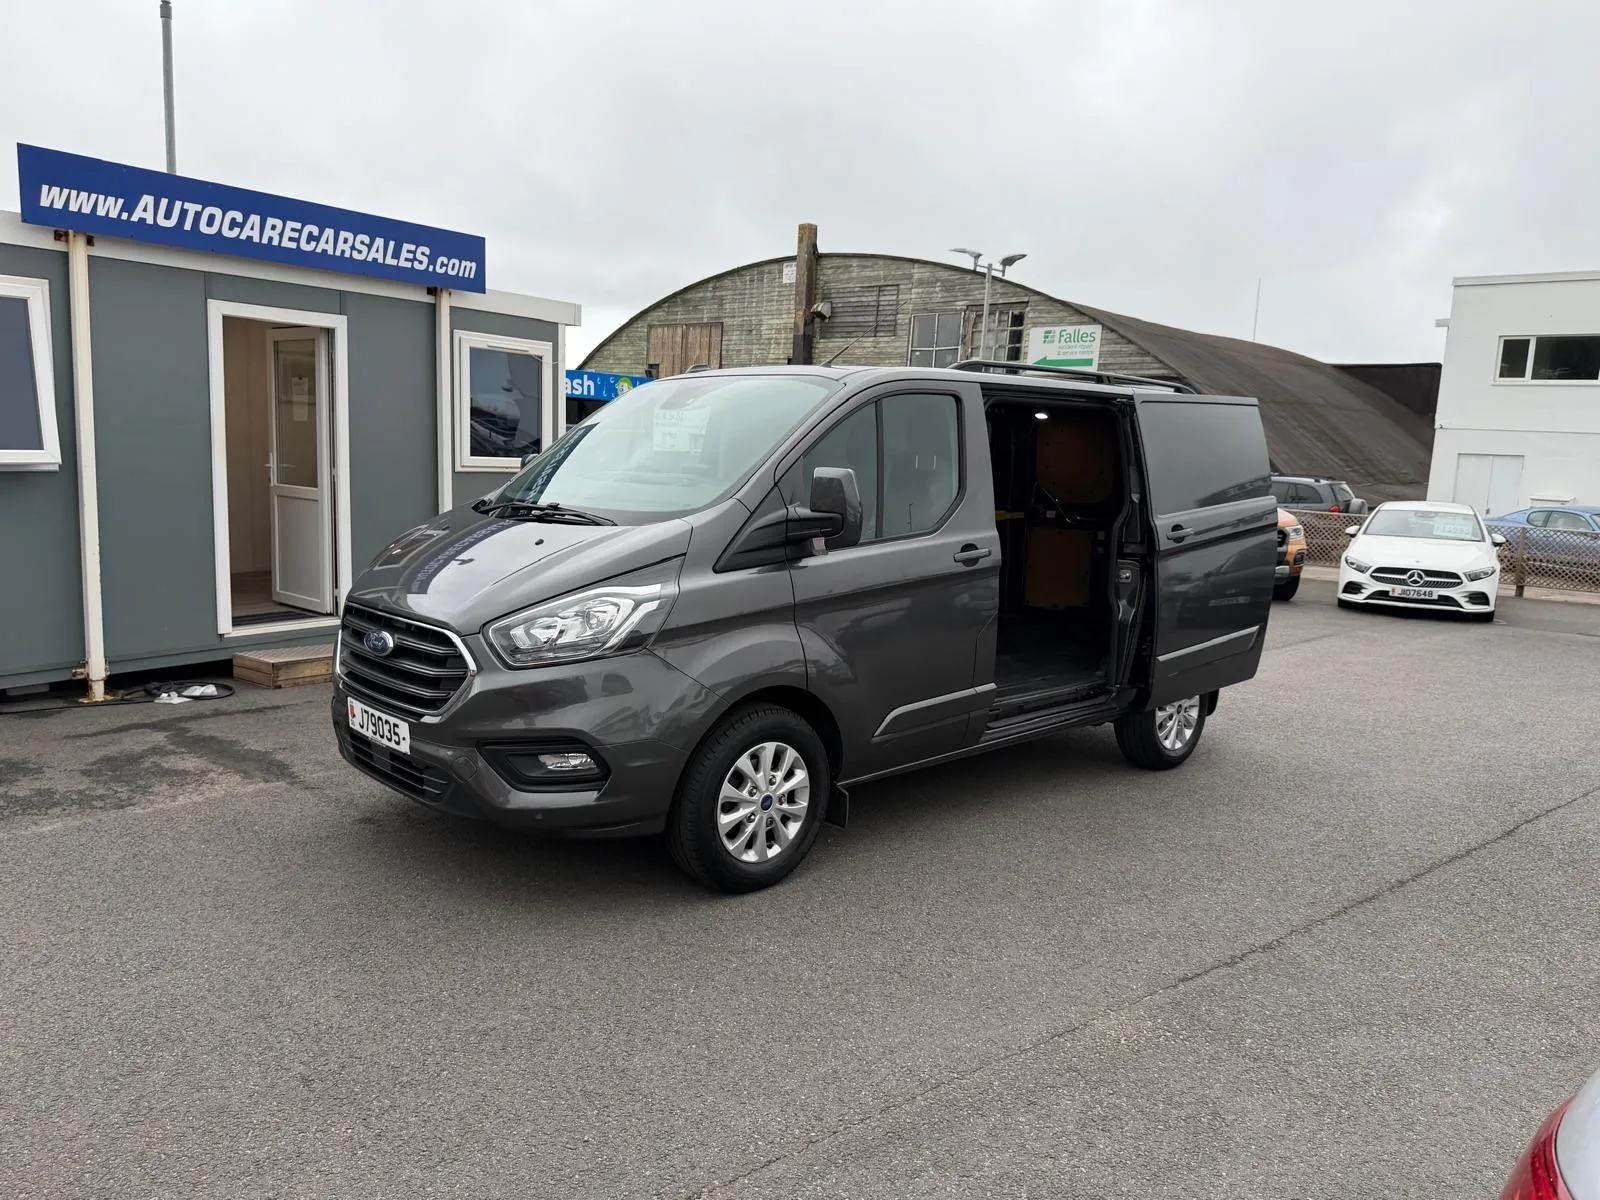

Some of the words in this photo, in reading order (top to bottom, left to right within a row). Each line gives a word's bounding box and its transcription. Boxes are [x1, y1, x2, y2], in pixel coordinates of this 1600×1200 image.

[40, 184, 477, 280] www.AUTOCARECARSALES.com
[1058, 328, 1097, 344] Falles
[359, 708, 401, 746] J79035
